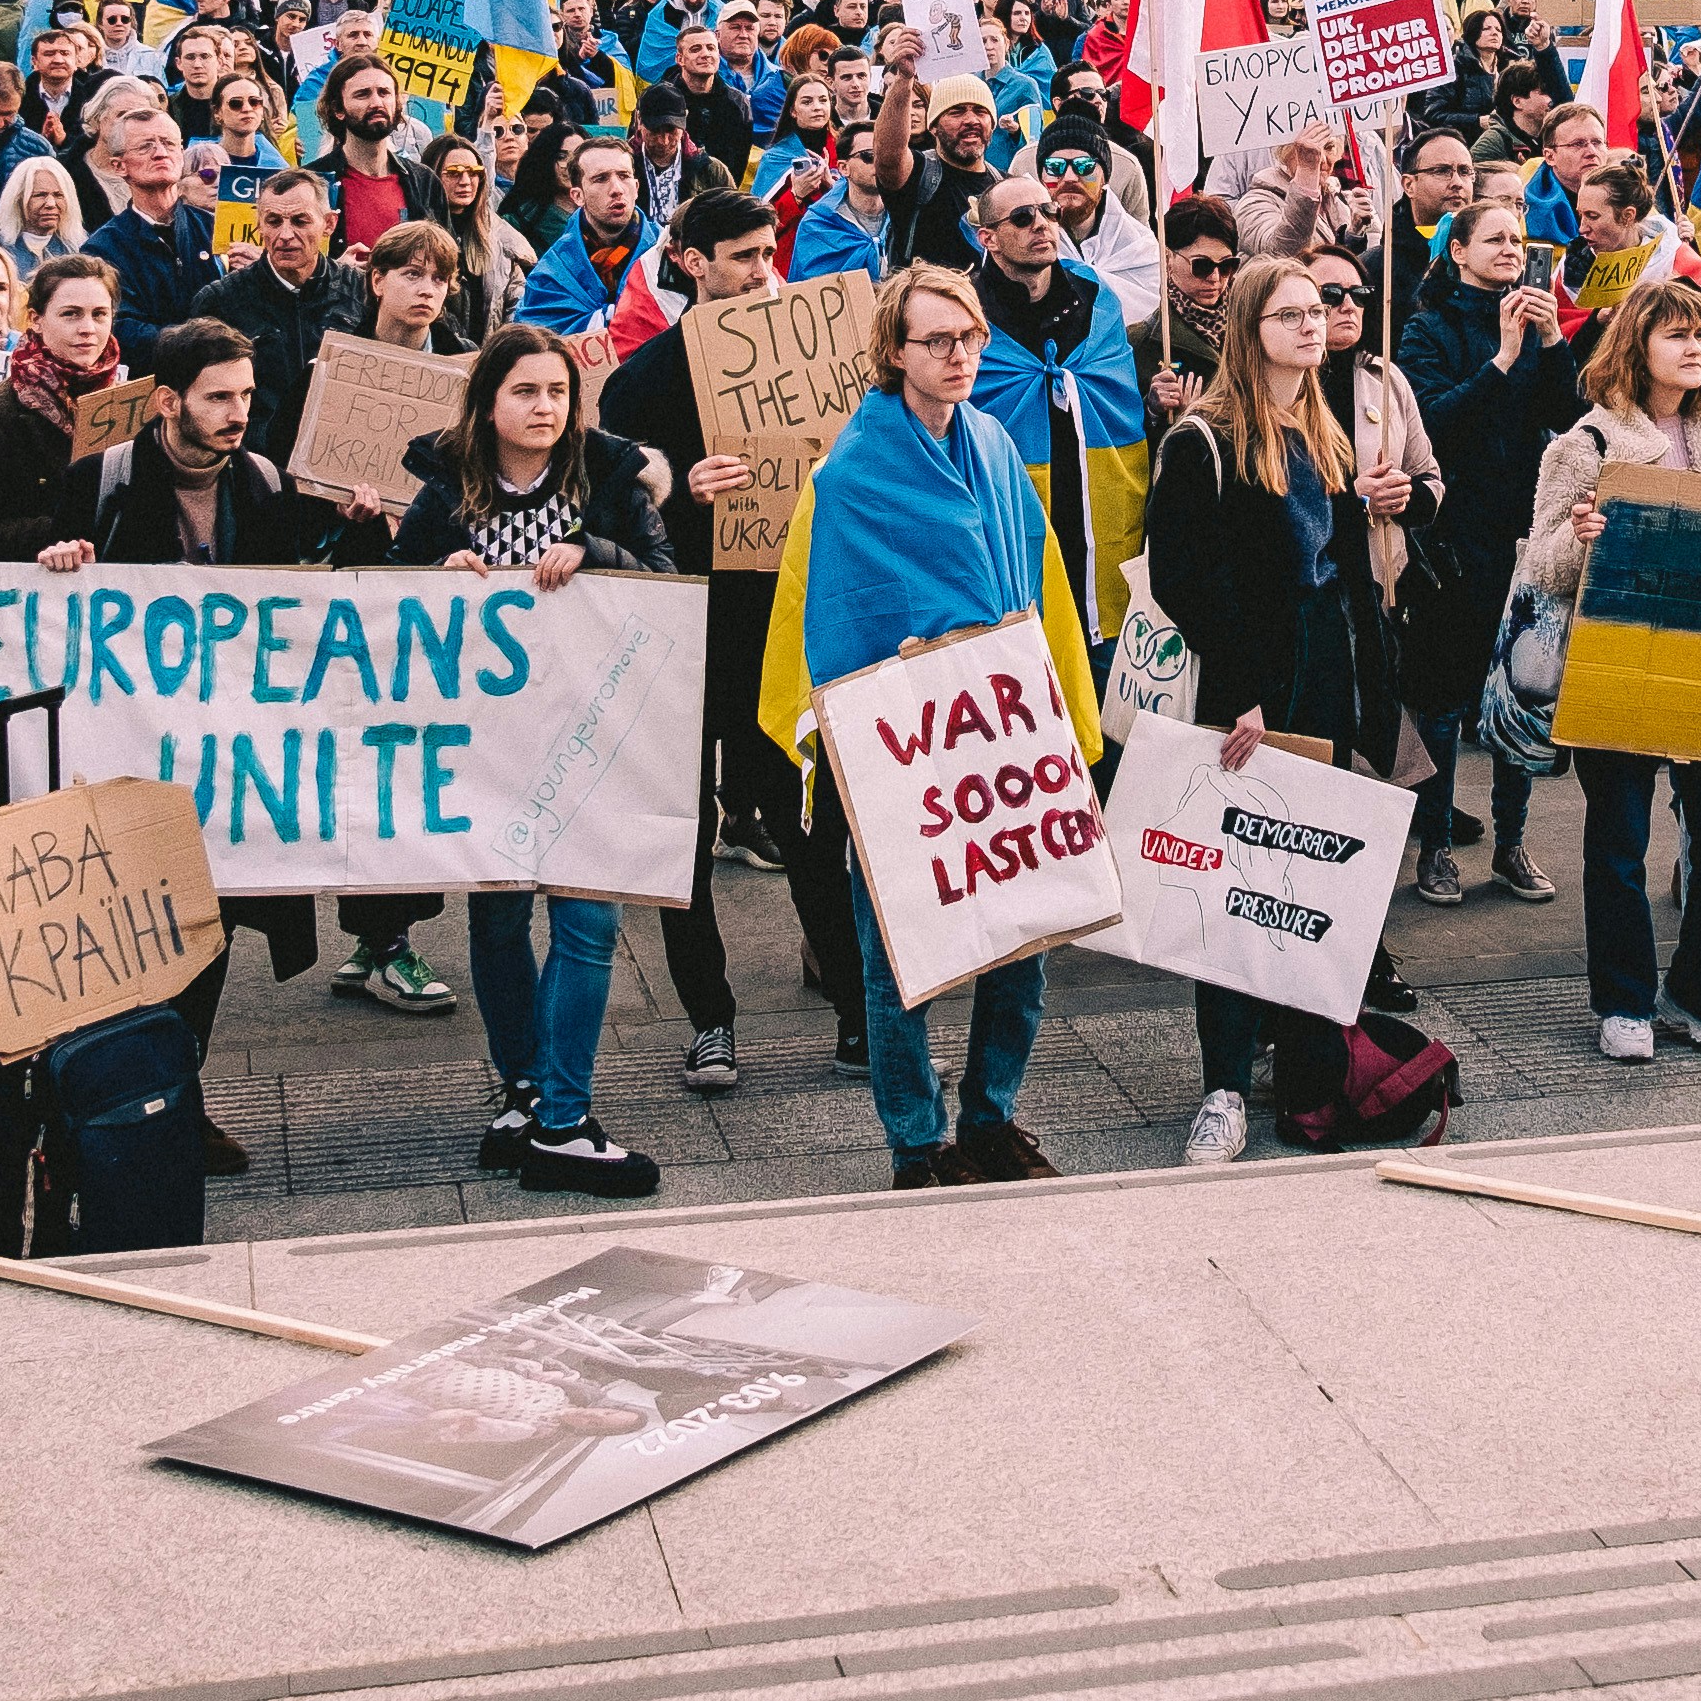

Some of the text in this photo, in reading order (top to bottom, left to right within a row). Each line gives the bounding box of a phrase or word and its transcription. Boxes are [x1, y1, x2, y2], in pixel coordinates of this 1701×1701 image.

[380, 17, 479, 65] MEMORANDUM
[1320, 14, 1364, 41] UK,
[1324, 17, 1430, 60] DELIVER
[384, 54, 462, 106] 1994
[1327, 36, 1440, 78] ON YOUR
[1331, 55, 1442, 99] PROMISE
[718, 286, 845, 379] STOP
[346, 393, 418, 438] FOR
[718, 370, 806, 432] THE
[875, 673, 1038, 767] WAR
[160, 722, 473, 845] UNITE
[1142, 832, 1218, 870] UNDER
[1233, 813, 1350, 861] DEMOCRACY
[930, 823, 1041, 907] LAST
[1228, 890, 1326, 941] PRESSURE
[362, 1332, 488, 1389] maternity
[276, 1385, 366, 1426] centre
[620, 1370, 808, 1458] 9.03.2022
